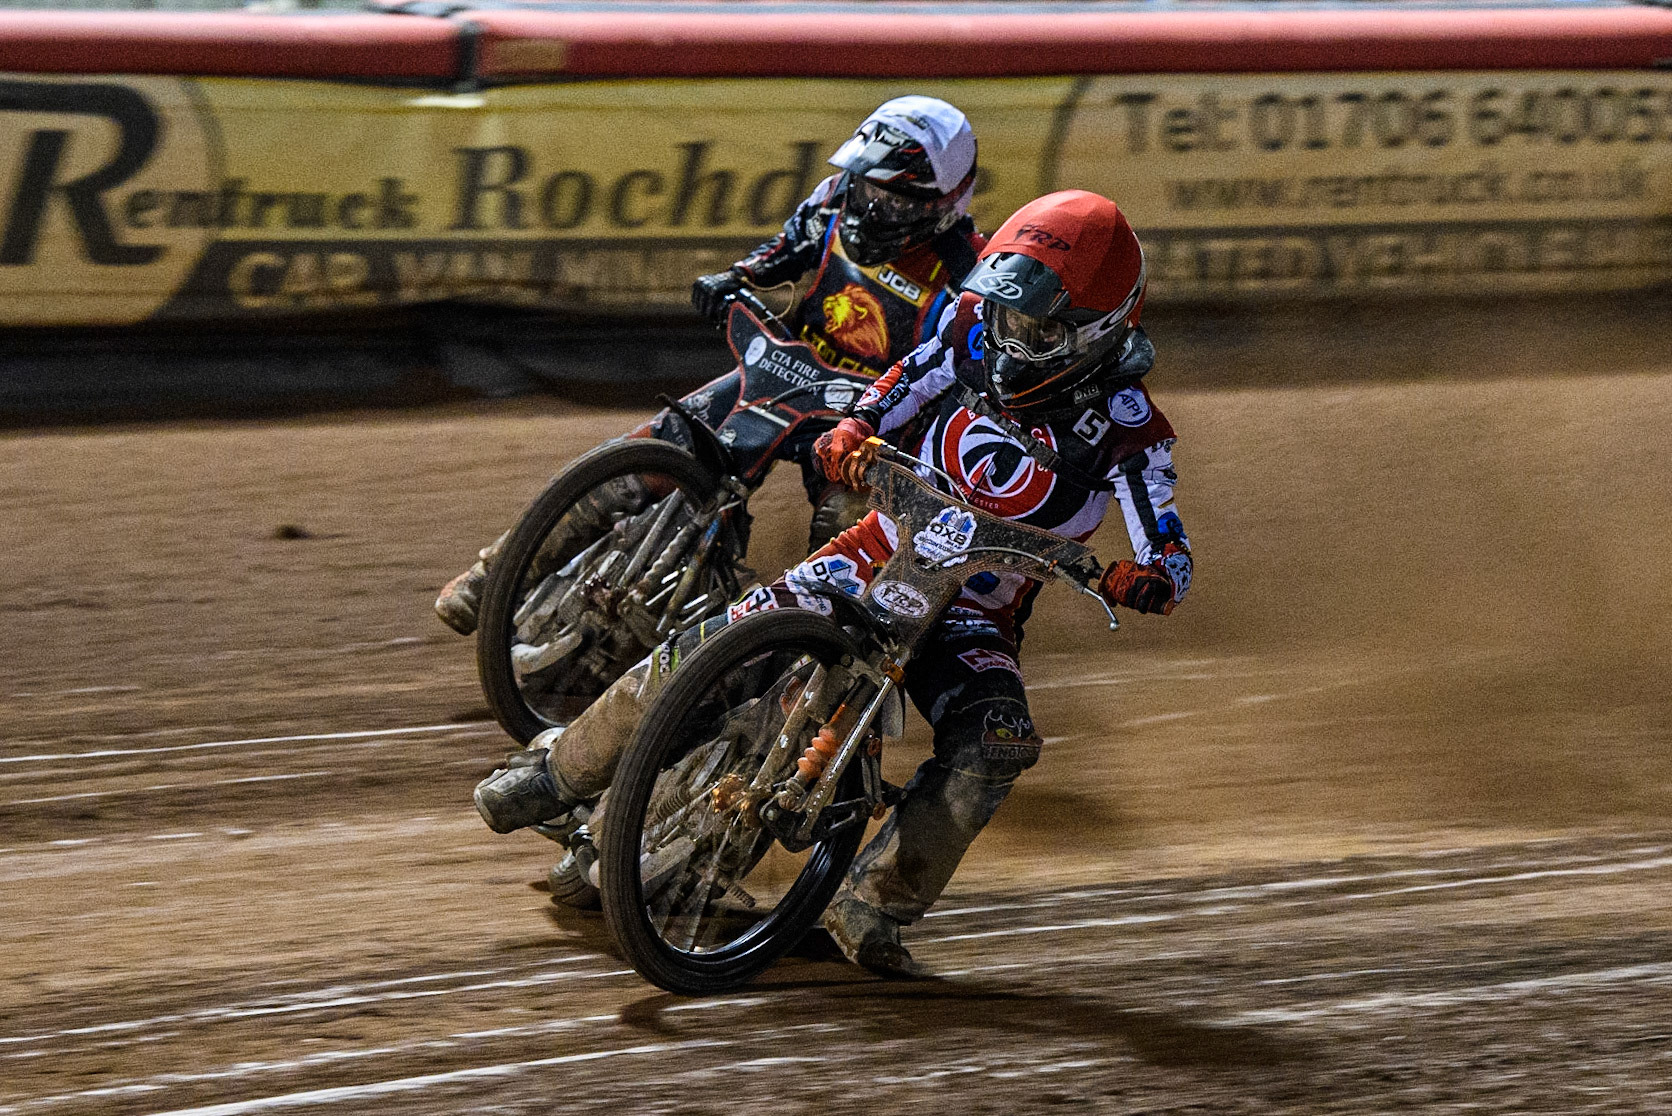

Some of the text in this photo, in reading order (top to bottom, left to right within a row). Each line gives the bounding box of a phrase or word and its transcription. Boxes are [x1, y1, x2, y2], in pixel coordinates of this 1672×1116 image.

[878, 270, 920, 300] JCB
[758, 358, 822, 396] DETECTION
[771, 350, 792, 367] CTA
[792, 360, 821, 381] FIRE
[1077, 411, 1107, 441] 5
